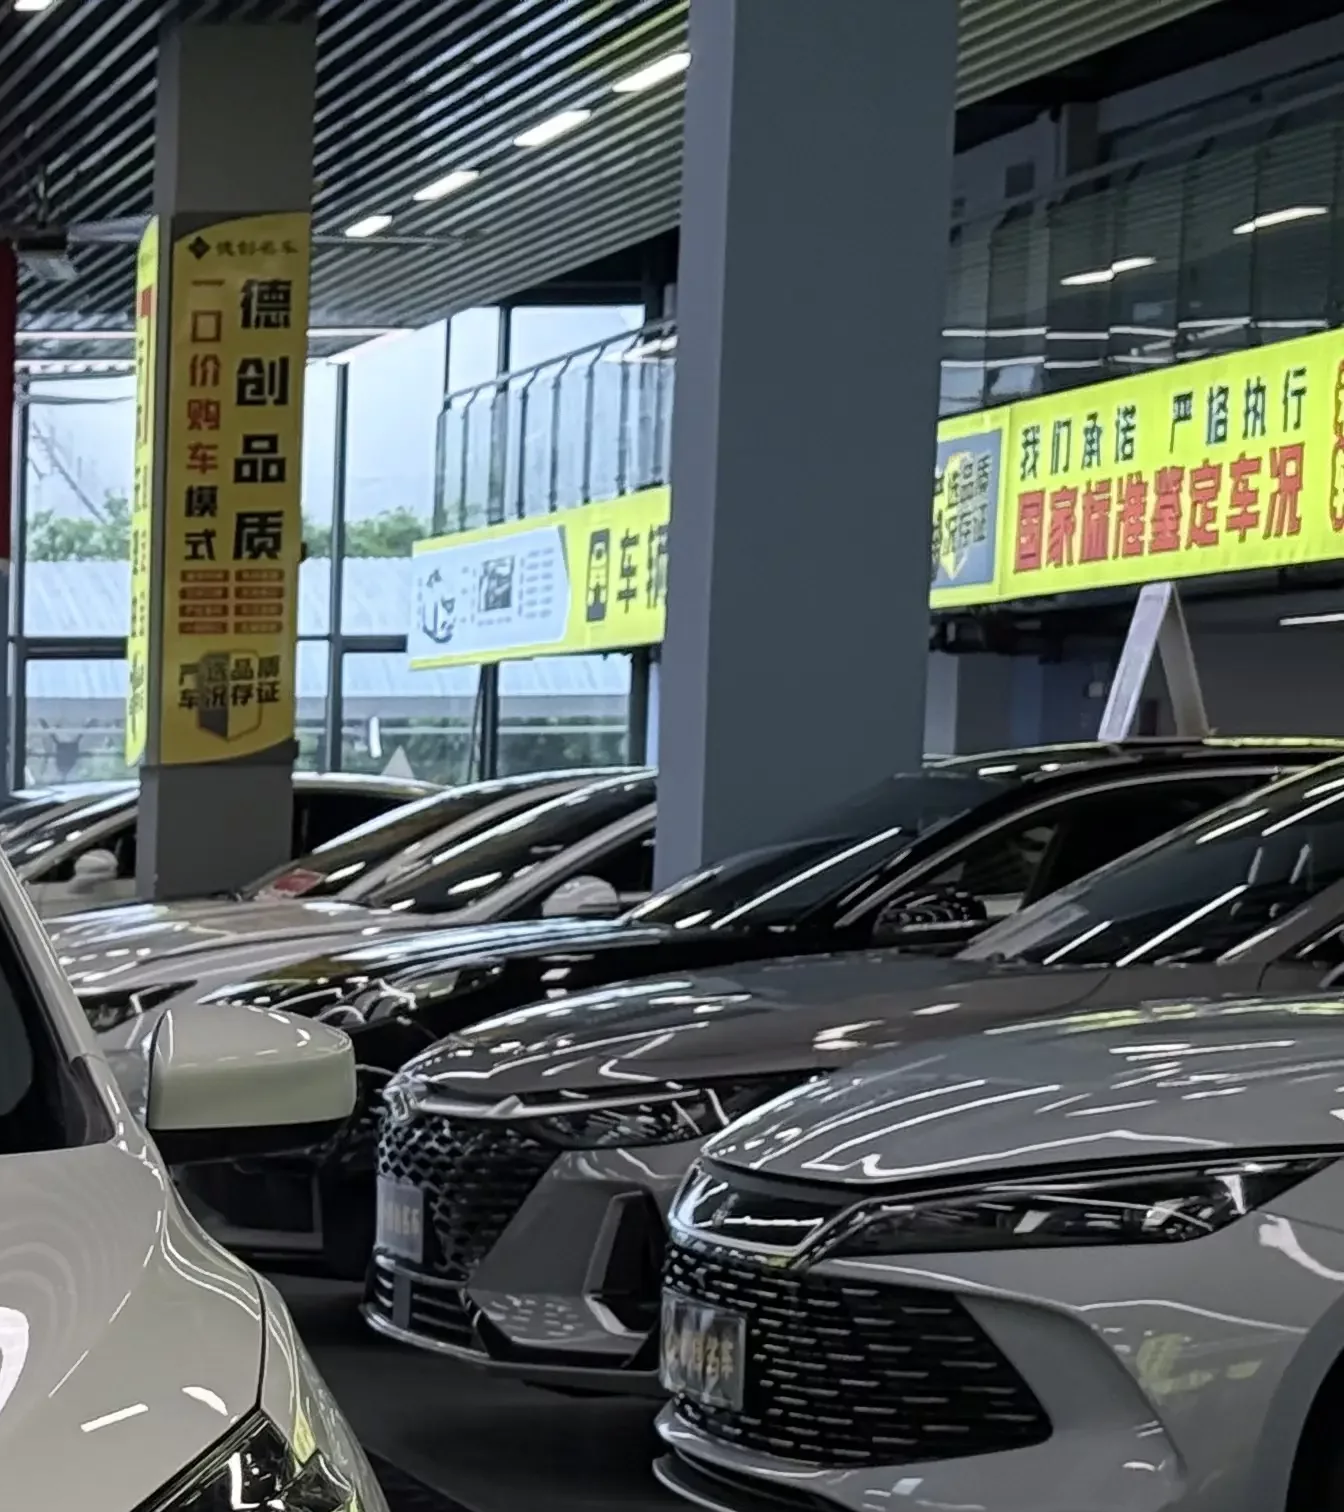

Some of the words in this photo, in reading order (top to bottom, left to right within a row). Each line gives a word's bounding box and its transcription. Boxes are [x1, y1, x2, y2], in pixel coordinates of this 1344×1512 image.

[184, 279, 225, 562] 一口价购车模式
[232, 279, 292, 560] 德创品质
[1014, 441, 1306, 575] 国家标准鉴定车况
[1019, 403, 1137, 481] 我们承诺
[1169, 366, 1307, 453] 严格执行
